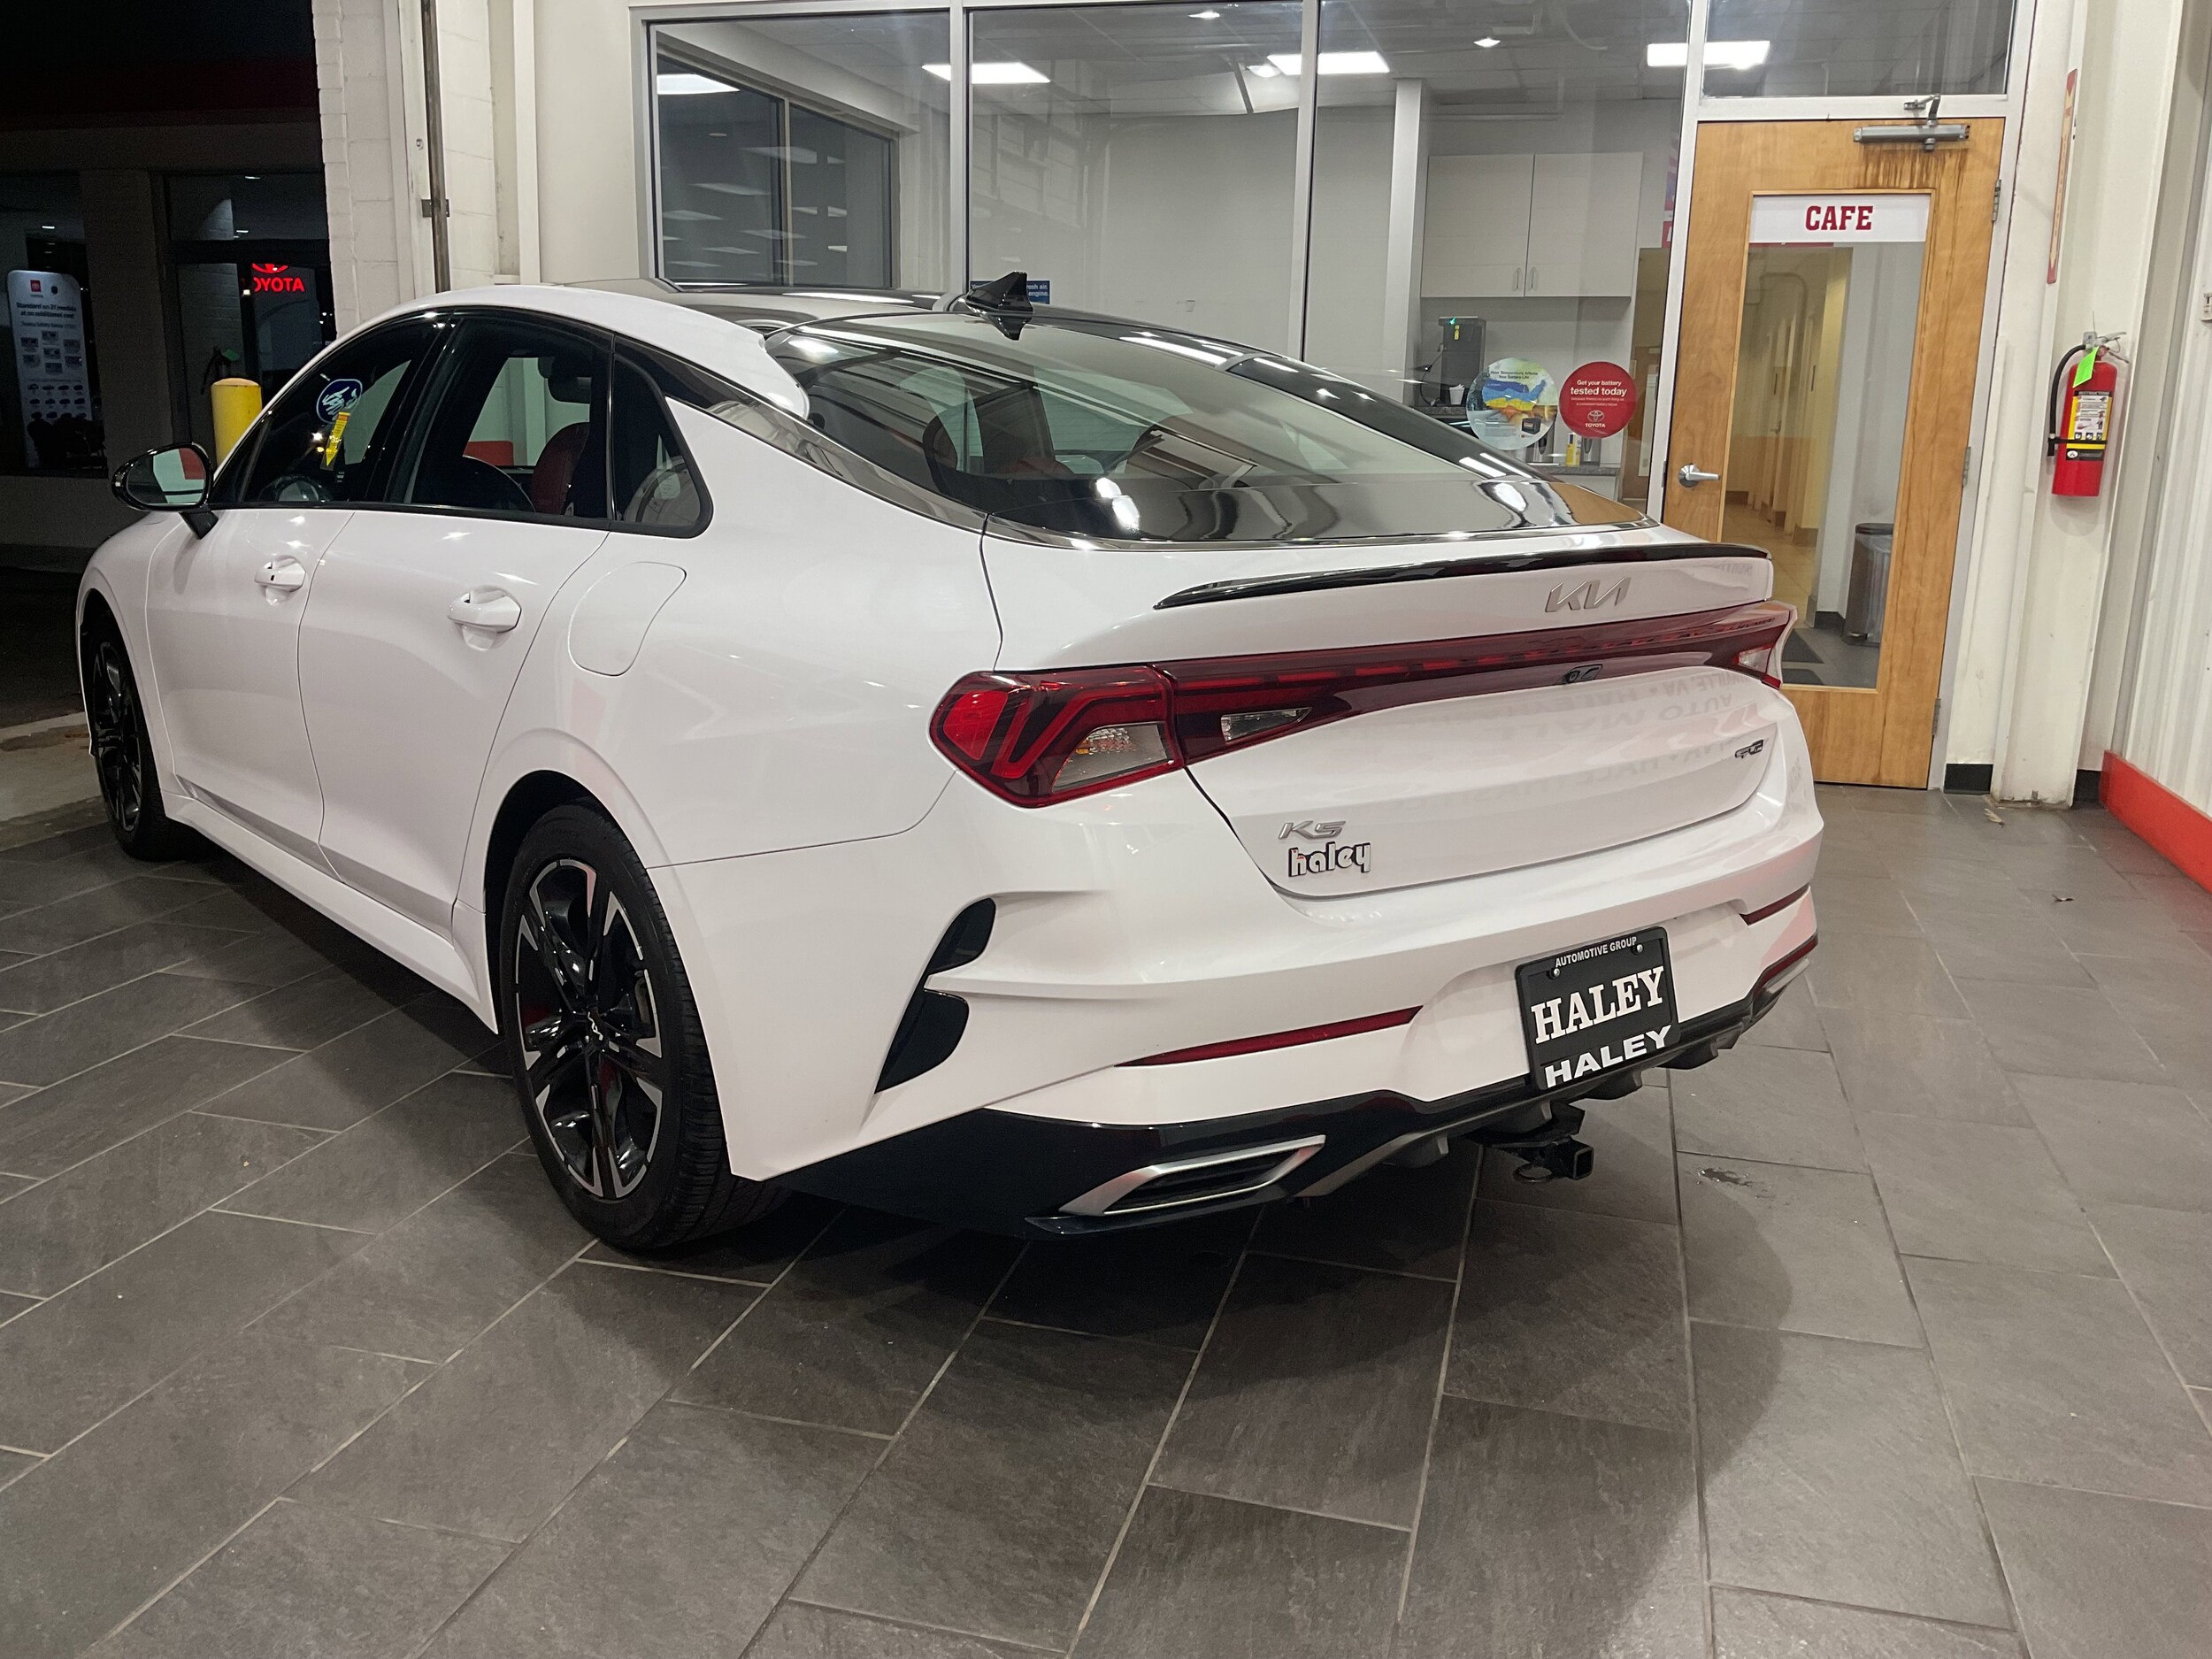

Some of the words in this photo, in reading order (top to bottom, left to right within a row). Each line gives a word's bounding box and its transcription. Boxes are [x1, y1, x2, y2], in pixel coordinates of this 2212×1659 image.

[1805, 205, 1873, 231] CAFE
[253, 277, 305, 293] OYOTA
[1571, 387, 1599, 396] tested
[1601, 387, 1627, 396] today
[1278, 820, 1346, 840] K5
[1288, 841, 1371, 877] haley
[1555, 944, 1609, 968] AUTOMOTIVE
[1609, 936, 1637, 954] GROUP
[1531, 965, 1664, 1045] HALEY
[1545, 1025, 1672, 1088] HALEY
